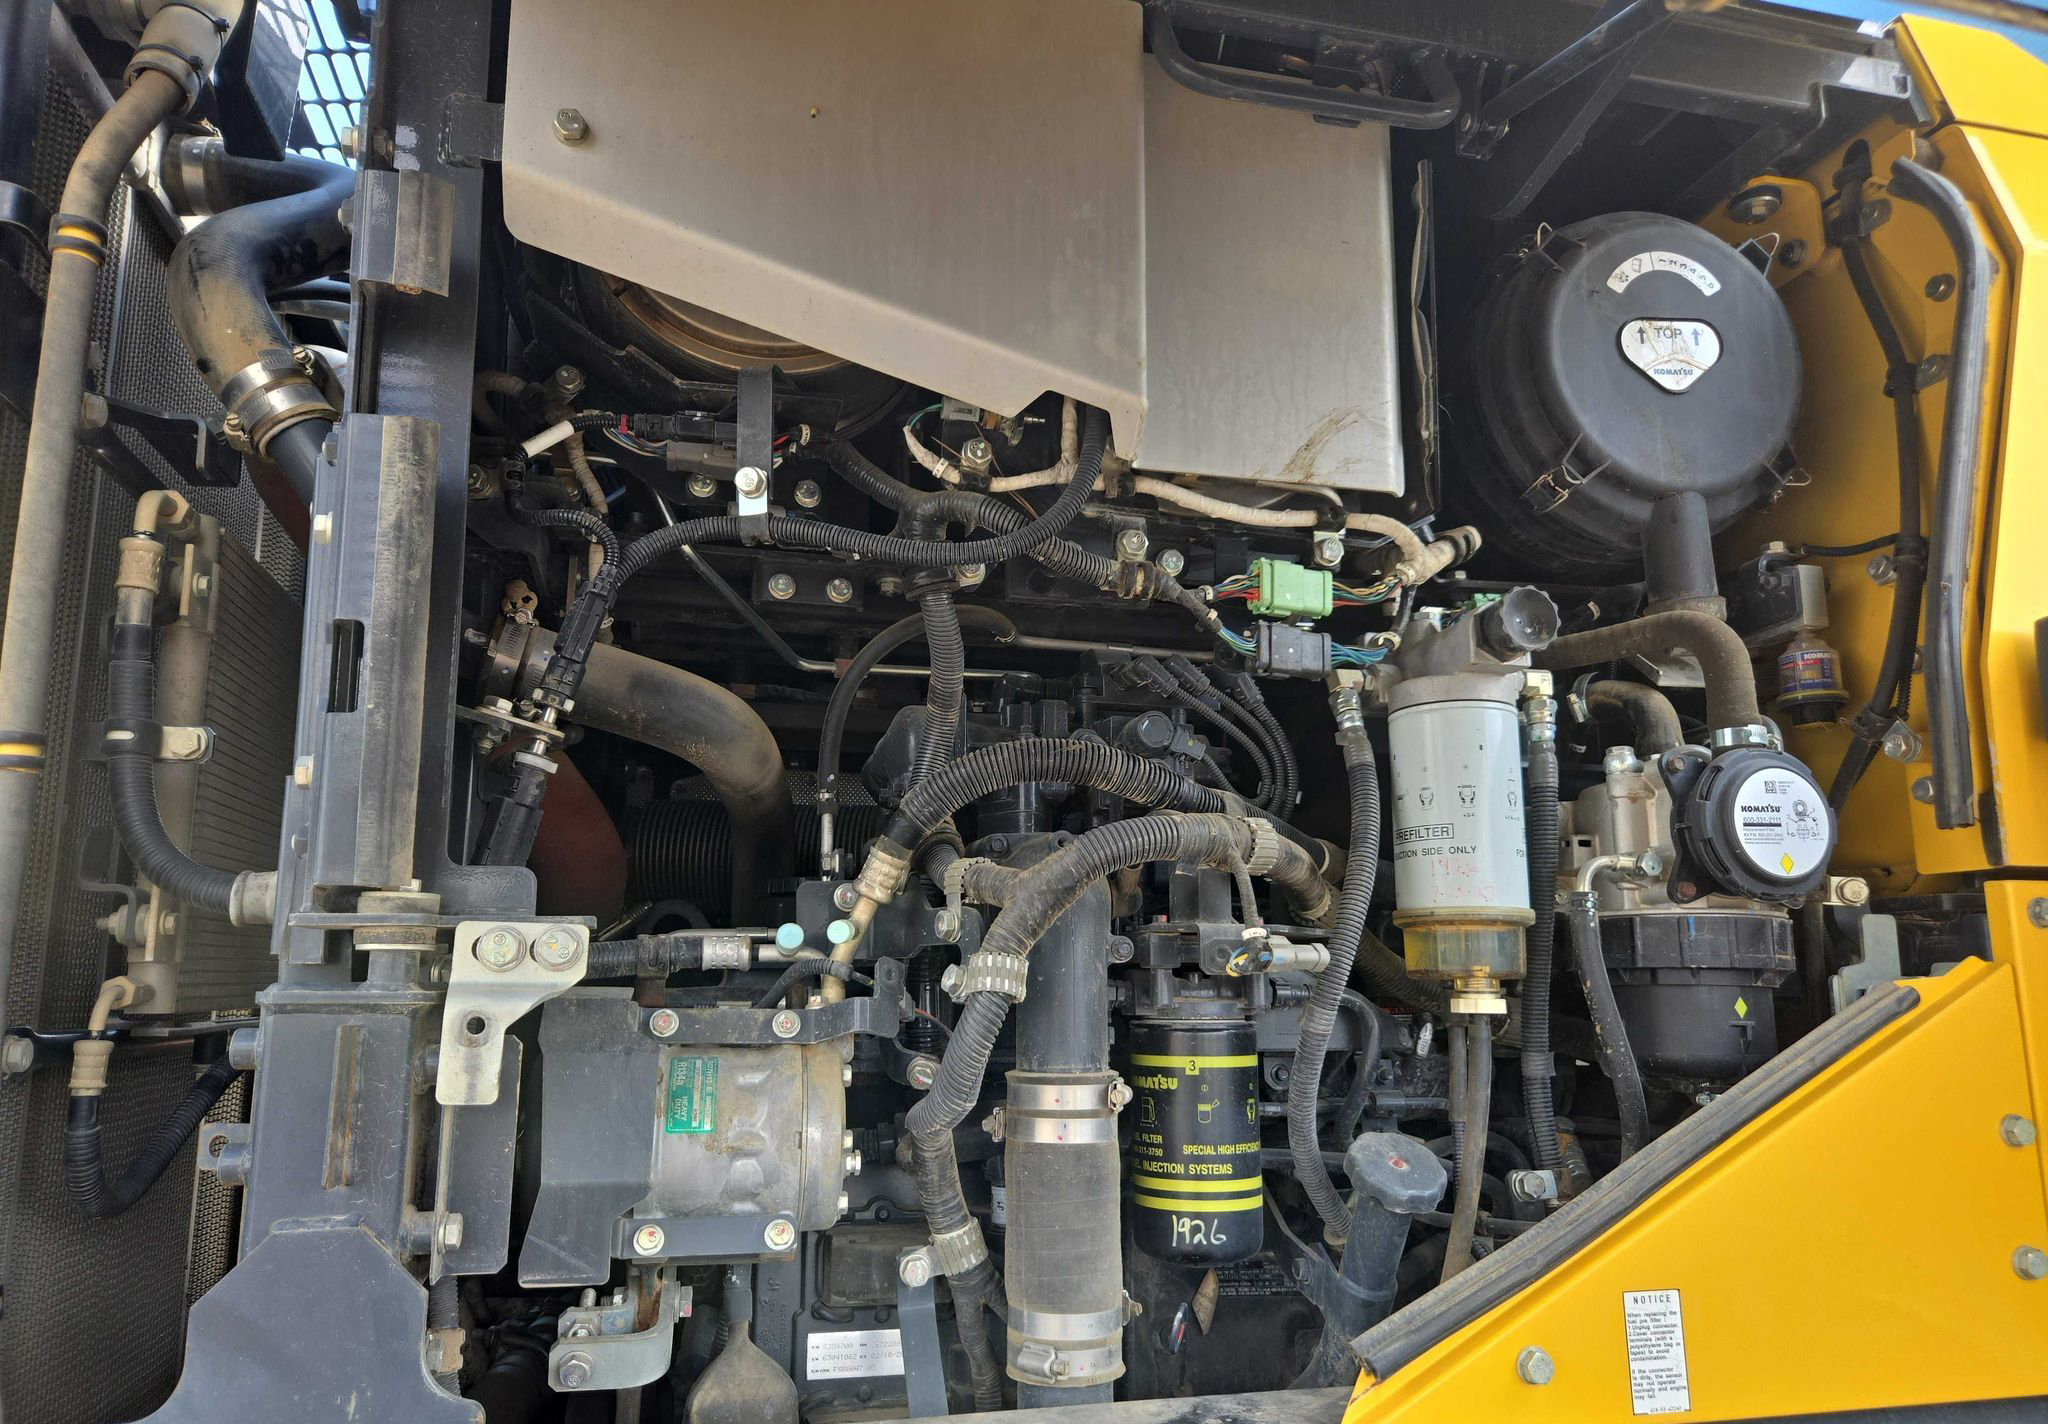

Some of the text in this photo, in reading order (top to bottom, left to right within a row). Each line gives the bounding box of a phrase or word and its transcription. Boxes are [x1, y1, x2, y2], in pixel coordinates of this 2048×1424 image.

[1654, 326, 1682, 340] TOP
[1653, 367, 1693, 376] KOMATSU
[1741, 803, 1780, 813] KOMATSU
[1421, 846, 1443, 856] SIDE
[1448, 845, 1477, 855] ONLY
[1188, 1059, 1196, 1072] 3
[1136, 1074, 1178, 1090] MATSU
[681, 1096, 689, 1121] HEAVY
[1142, 1133, 1163, 1144] FILTER
[1183, 1144, 1216, 1155] SPECIAL
[1218, 1144, 1235, 1154] HIGH
[1143, 1160, 1185, 1174] INJECTION
[1189, 1163, 1233, 1175] SYSTEMS
[1172, 1215, 1227, 1247] 1926
[1633, 1294, 1671, 1304] NOTICE
